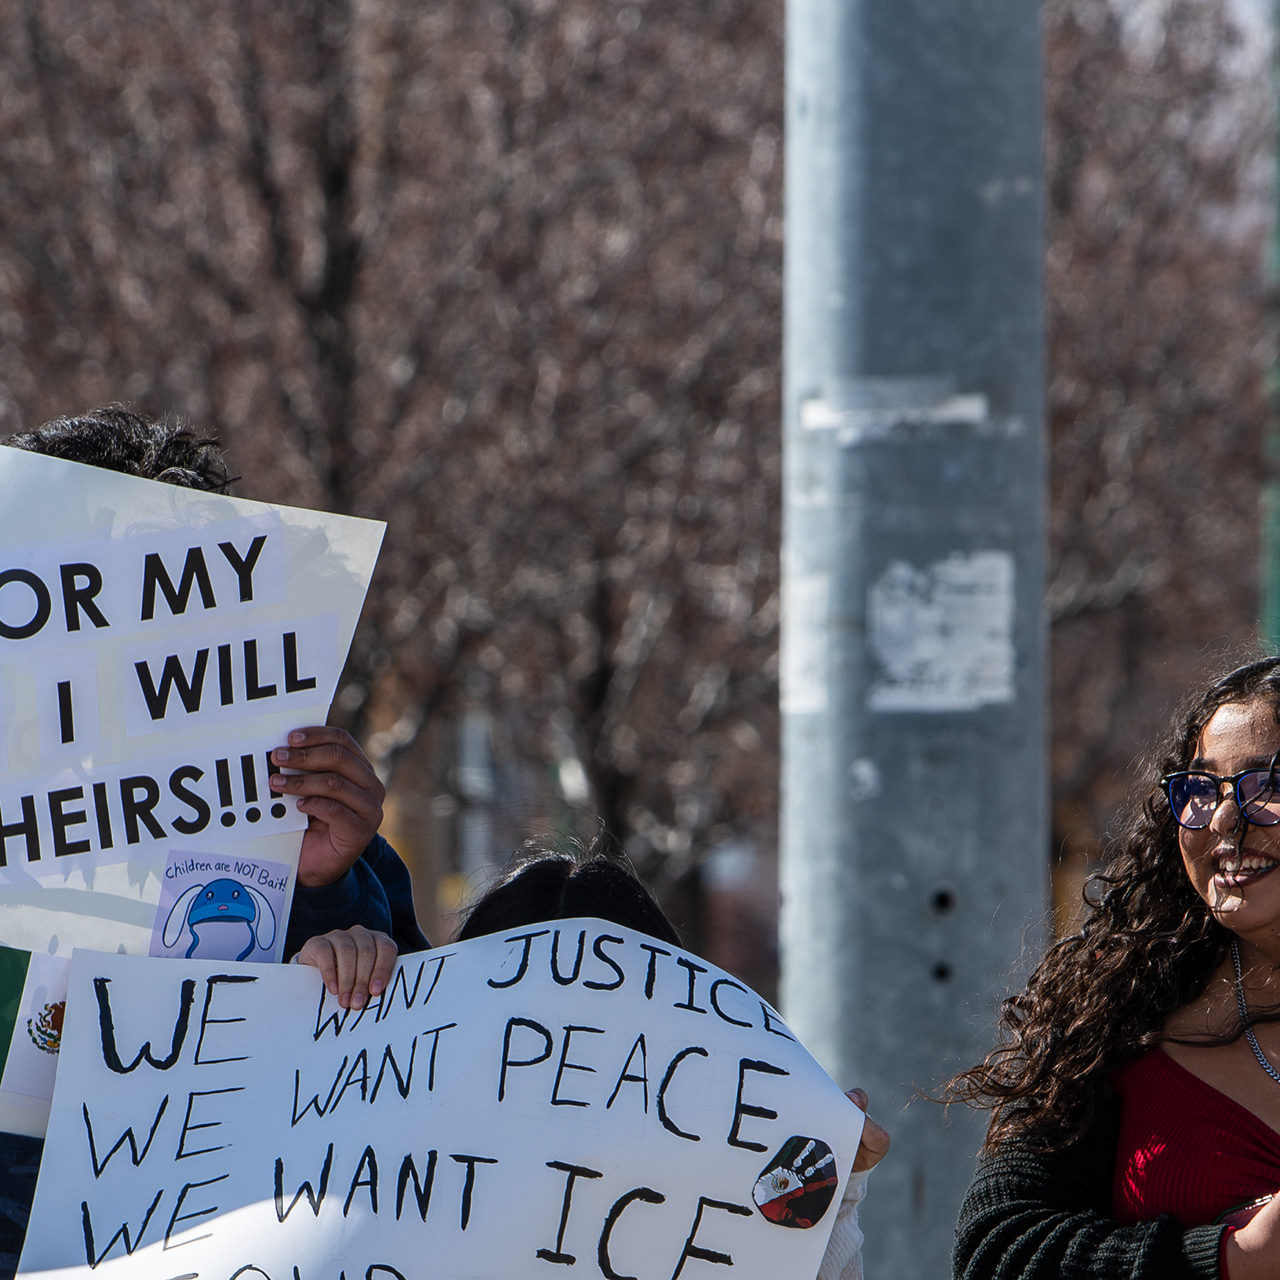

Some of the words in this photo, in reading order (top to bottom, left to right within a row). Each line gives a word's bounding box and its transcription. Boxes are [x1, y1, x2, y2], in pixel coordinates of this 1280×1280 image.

[140, 535, 268, 621] MY
[57, 680, 75, 744] I
[134, 632, 317, 721] WILL
[165, 858, 212, 880] Children
[214, 861, 231, 873] are
[233, 860, 259, 879] NOT
[257, 868, 288, 892] Bait!
[92, 974, 260, 1075] WE
[313, 953, 458, 1041] WANT
[486, 929, 797, 1043] JUSTICE
[82, 1087, 249, 1179] WE
[291, 1022, 459, 1126] WANT
[496, 1016, 791, 1153] PEACE
[81, 1174, 230, 1269] WE
[274, 1142, 499, 1231] WANT
